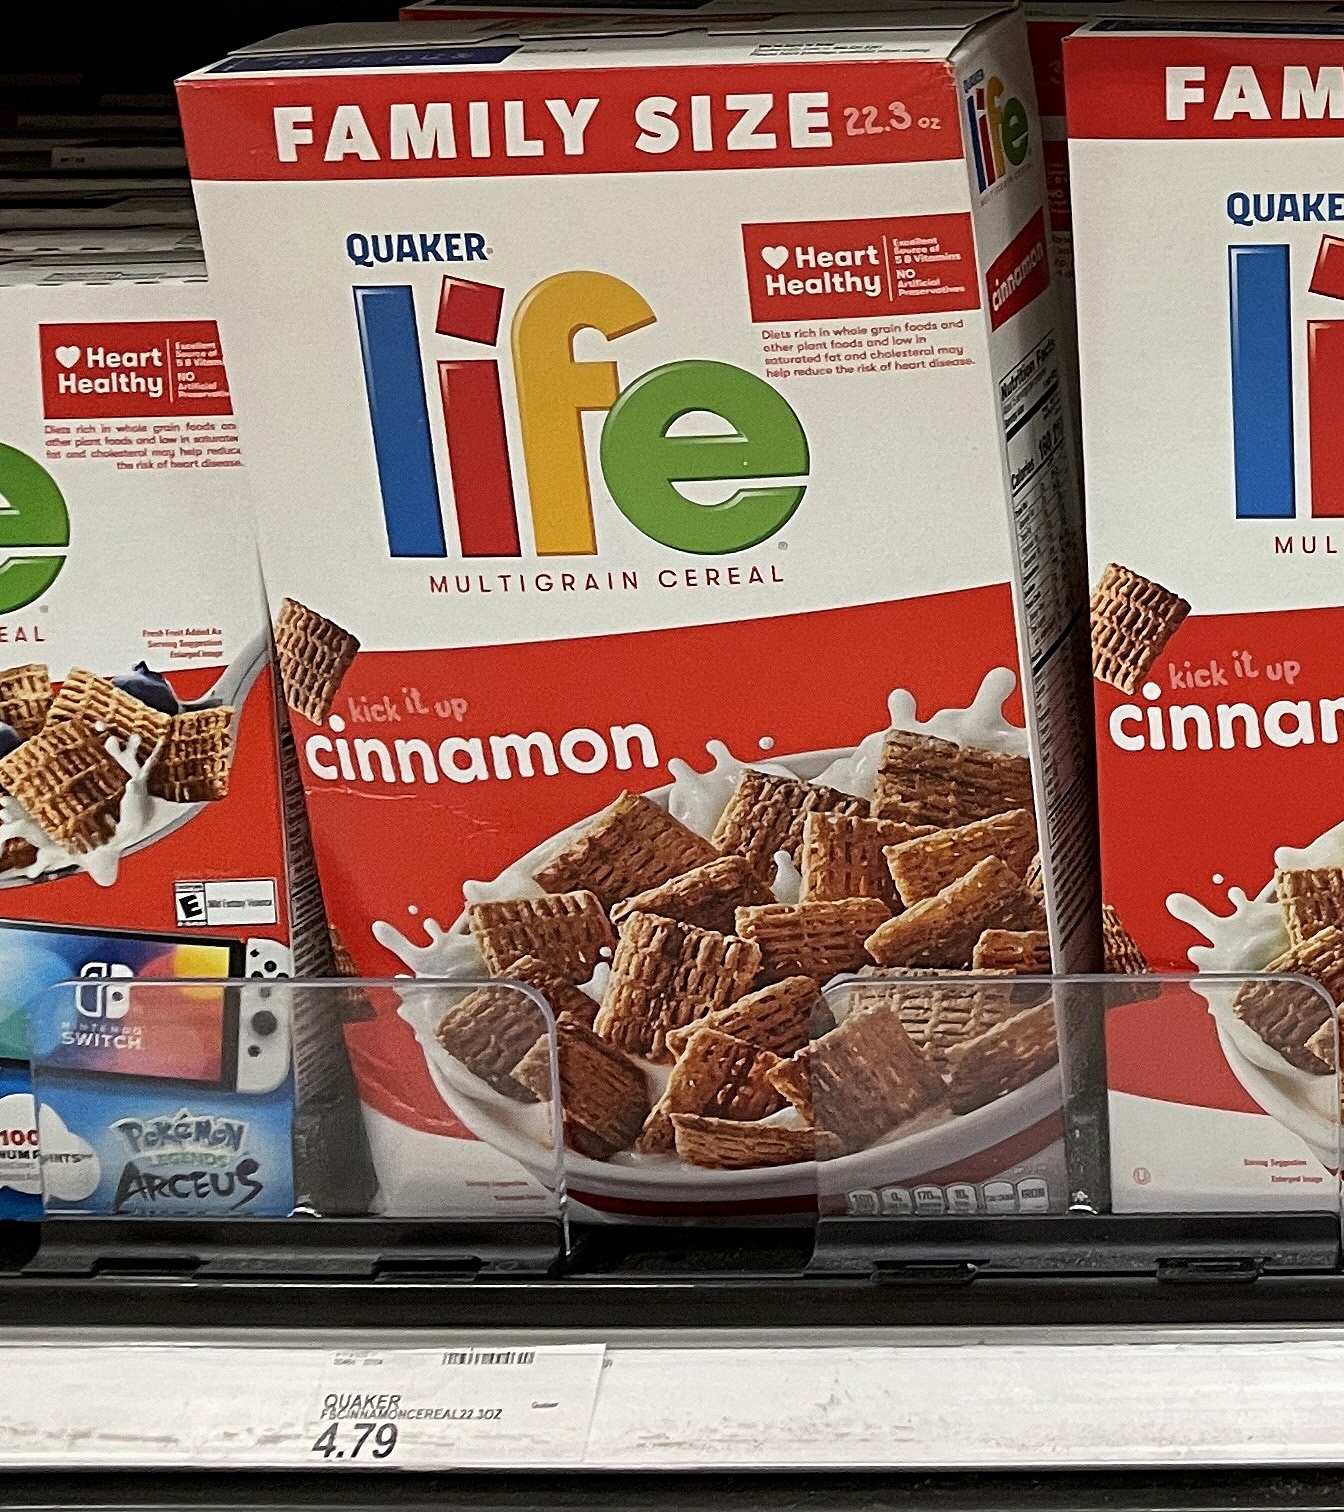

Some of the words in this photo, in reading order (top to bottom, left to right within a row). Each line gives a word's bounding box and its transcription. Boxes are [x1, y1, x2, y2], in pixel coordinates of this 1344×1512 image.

[274, 99, 600, 163] FAMILY
[634, 92, 832, 153] SIZE
[843, 103, 911, 135] 22.3
[918, 116, 941, 130] oz
[347, 232, 487, 267] QUAKER
[797, 245, 879, 268] Heart
[766, 272, 881, 302] Healthy
[353, 271, 811, 558] life
[430, 572, 638, 593] MULTIGRAIN
[660, 565, 784, 587] CEREAL
[306, 717, 659, 785] cinnamon
[324, 1394, 400, 1409] QUAKER
[312, 1422, 398, 1458] 4.79
